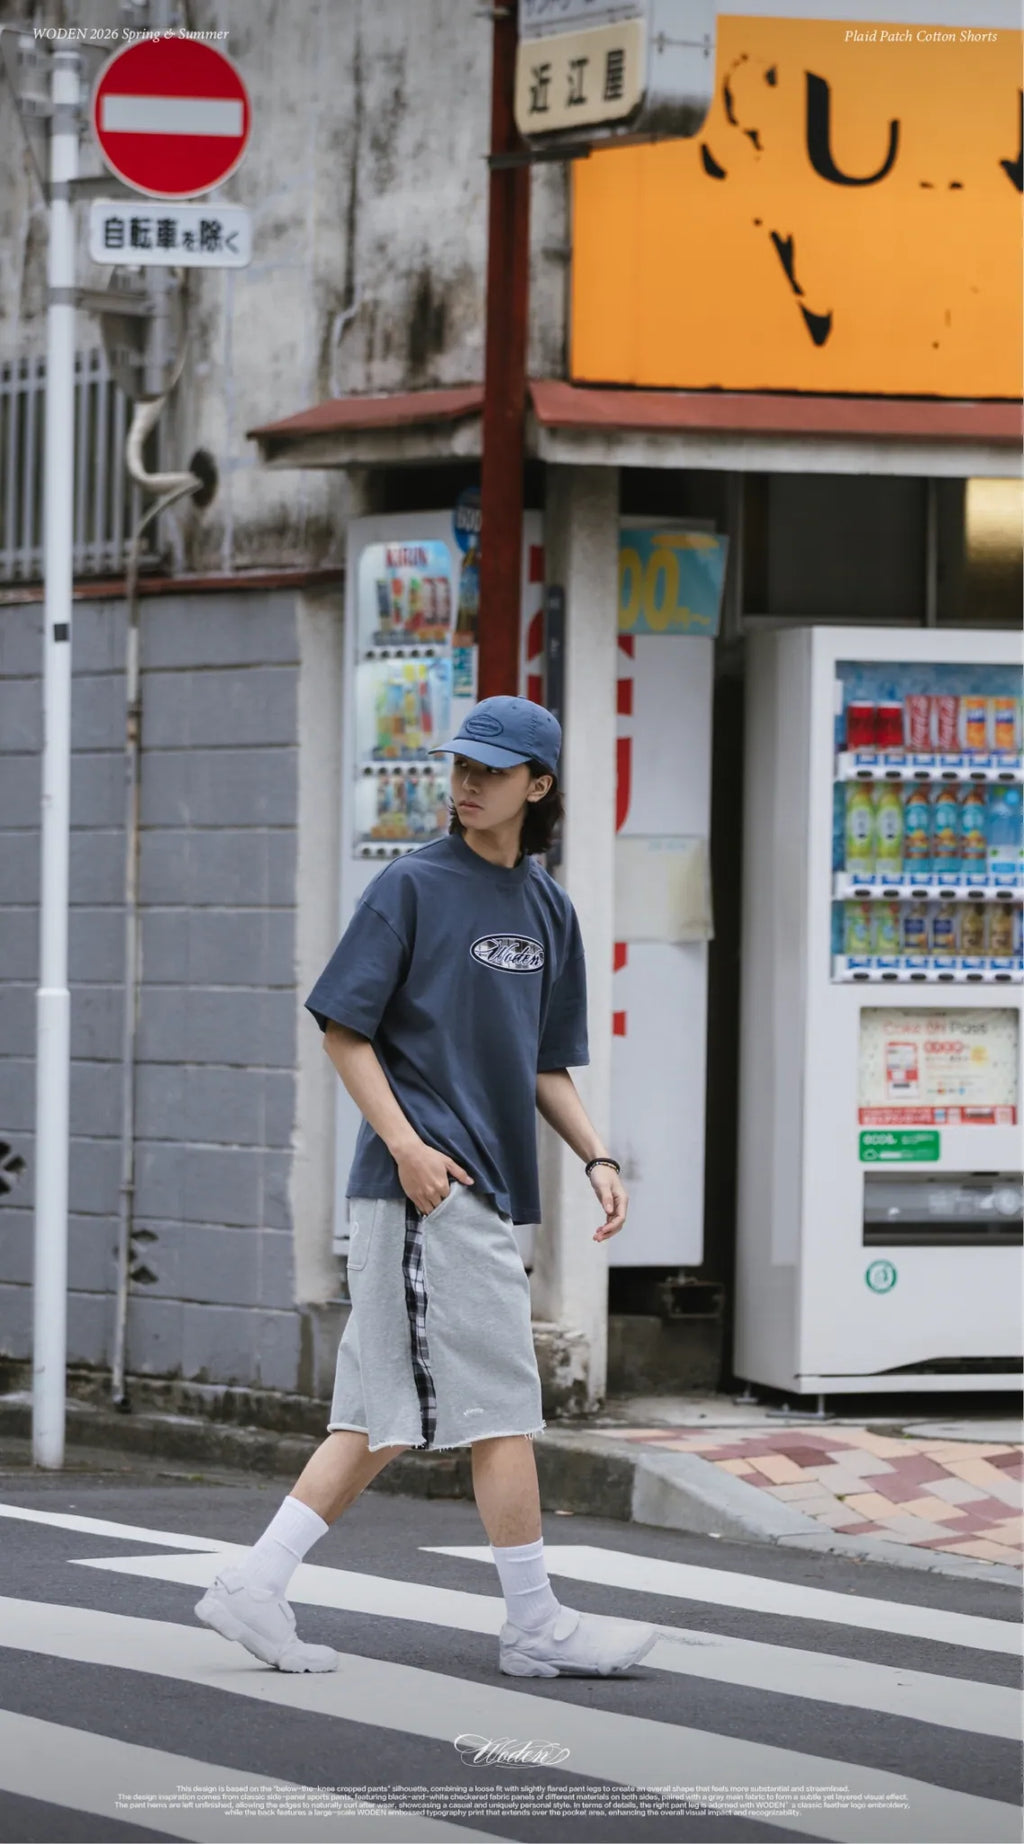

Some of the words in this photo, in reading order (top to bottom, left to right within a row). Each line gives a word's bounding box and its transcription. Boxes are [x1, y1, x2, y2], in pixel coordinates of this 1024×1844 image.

[105, 216, 240, 252] 自転車を除く
